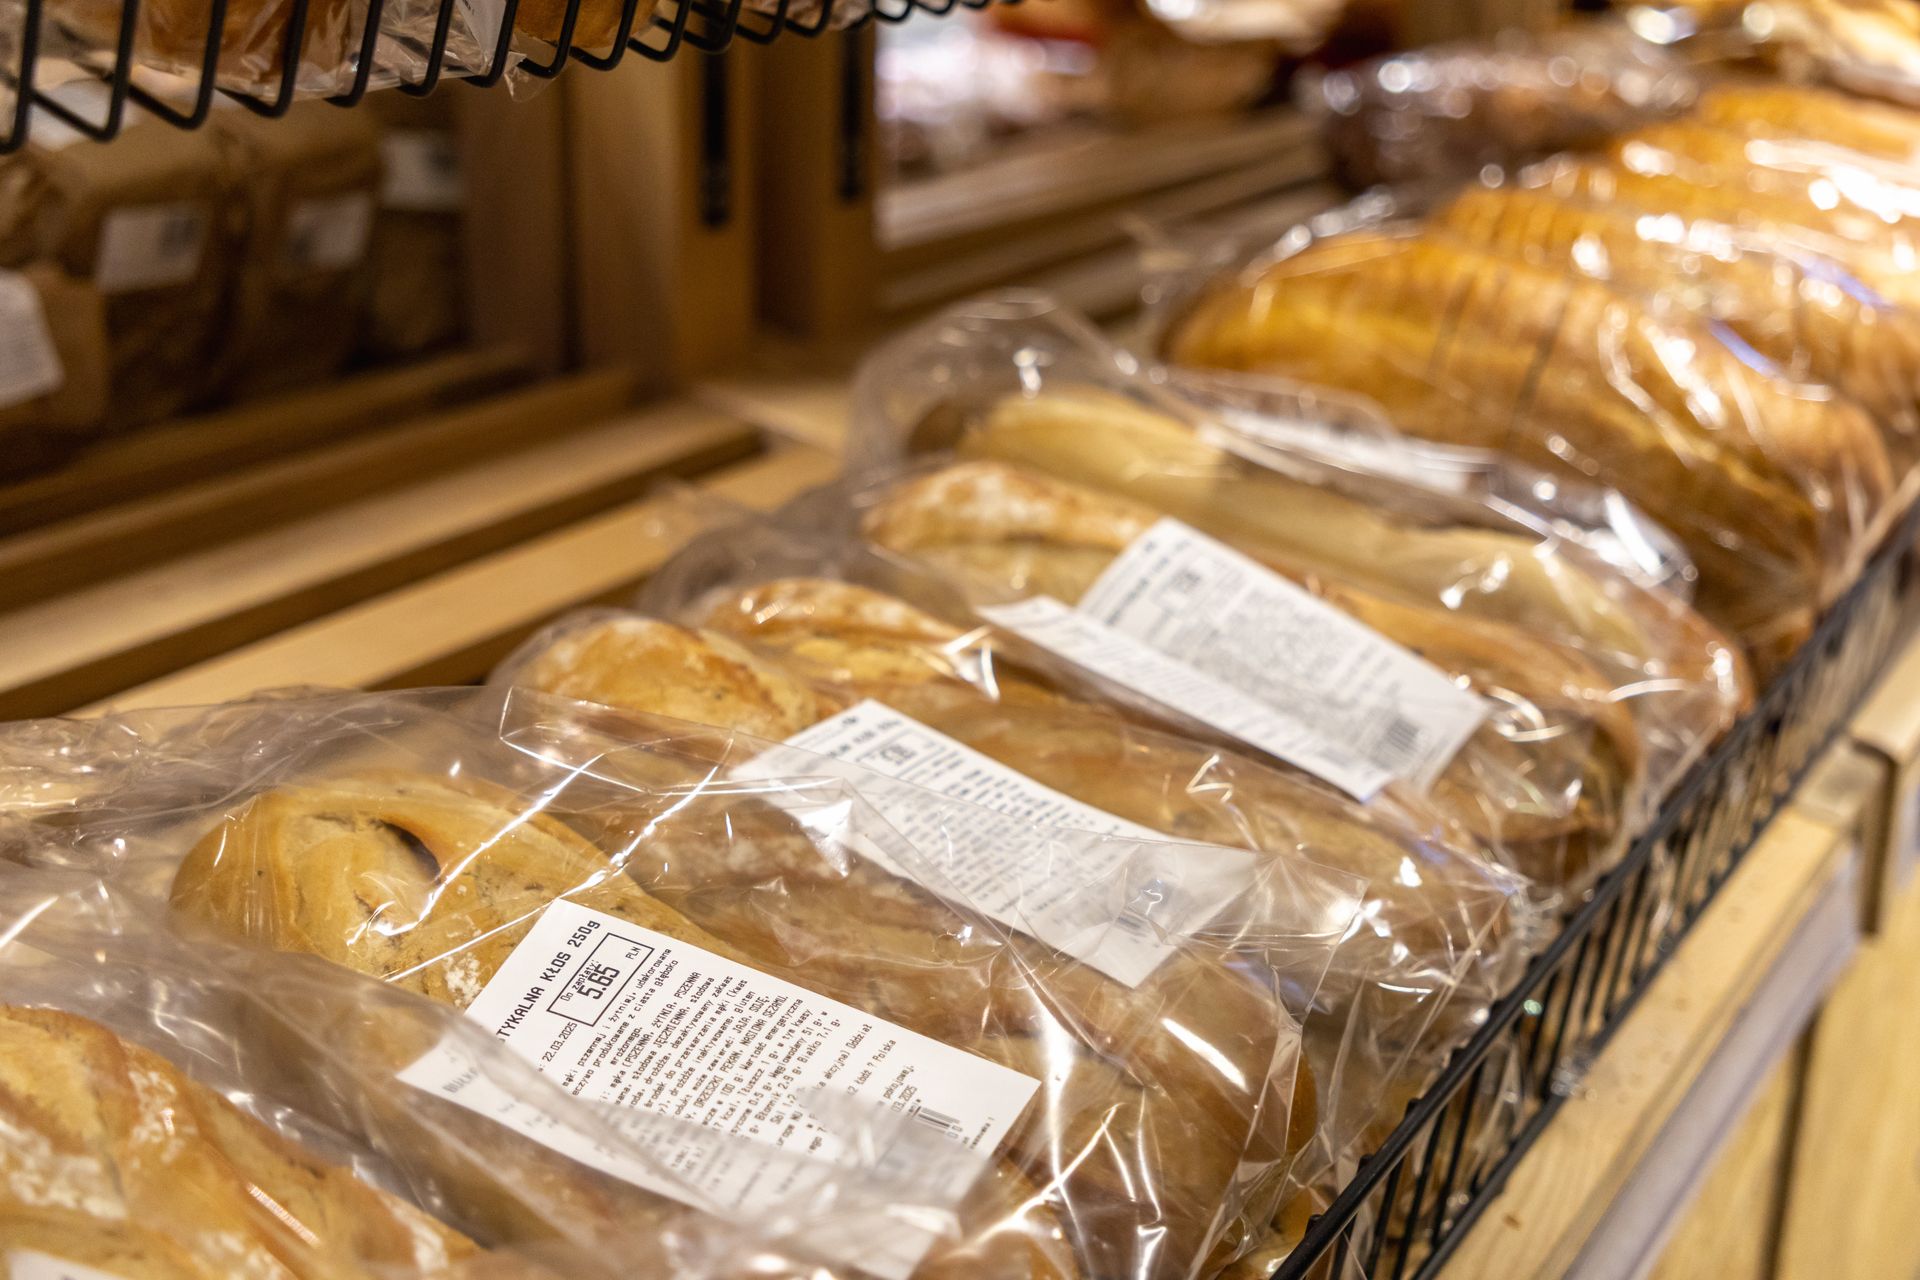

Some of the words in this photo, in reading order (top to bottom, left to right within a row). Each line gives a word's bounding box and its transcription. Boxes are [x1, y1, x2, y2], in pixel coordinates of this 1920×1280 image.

[495, 985, 545, 1042] TYKALNA
[538, 950, 571, 982] KŁOS
[566, 919, 601, 948] 250g
[558, 991, 574, 1002] Do
[570, 958, 599, 990] zapłaty:
[575, 962, 620, 1000] 5.65
[624, 945, 641, 960] PLN
[669, 998, 714, 1049] dezaktywowany
[710, 975, 733, 998] zakwas
[540, 1020, 578, 1062] 22.03.2025
[561, 1069, 578, 1087] mąki
[576, 1032, 607, 1067] pszennej
[607, 991, 637, 1023] żytniej,
[570, 1068, 595, 1096] eczywo
[591, 1020, 630, 1068] produkowane
[632, 987, 656, 1012] ciasta
[653, 959, 679, 987] głęboko
[609, 1069, 626, 1088] mąka
[672, 970, 702, 999] PSZENNA
[609, 1026, 643, 1066] mrożonego.
[630, 1049, 657, 1080] słodowa
[689, 976, 715, 1003] słodowa
[663, 1069, 677, 1080] do
[673, 1016, 717, 1068] przetwarzania
[713, 999, 730, 1015] mąki
[725, 978, 748, 998] (kwas
[668, 1066, 696, 1097] drożdże
[733, 990, 756, 1014] gluten
[692, 1074, 724, 1108] ORZESZKI
[738, 1017, 767, 1046] NASIONA
[719, 1082, 736, 1096] 100
[738, 1041, 767, 1071] Wartość
[763, 998, 803, 1041] energetyczna
[736, 1067, 765, 1096] Tłuszcz
[781, 1027, 796, 1040] tym
[789, 1008, 813, 1027] kwasy
[767, 1036, 807, 1079] Węglowodany
[800, 1025, 814, 1036] 51
[871, 1038, 897, 1062] Polska
[666, 1093, 693, 1121] odukt
[753, 1091, 781, 1121] Błonnik
[795, 1039, 822, 1063] Białko
[768, 1109, 785, 1125] Sól
[775, 1123, 795, 1147] urope
[823, 1049, 850, 1080] akcyjna)
[844, 1023, 873, 1049] Oddział
